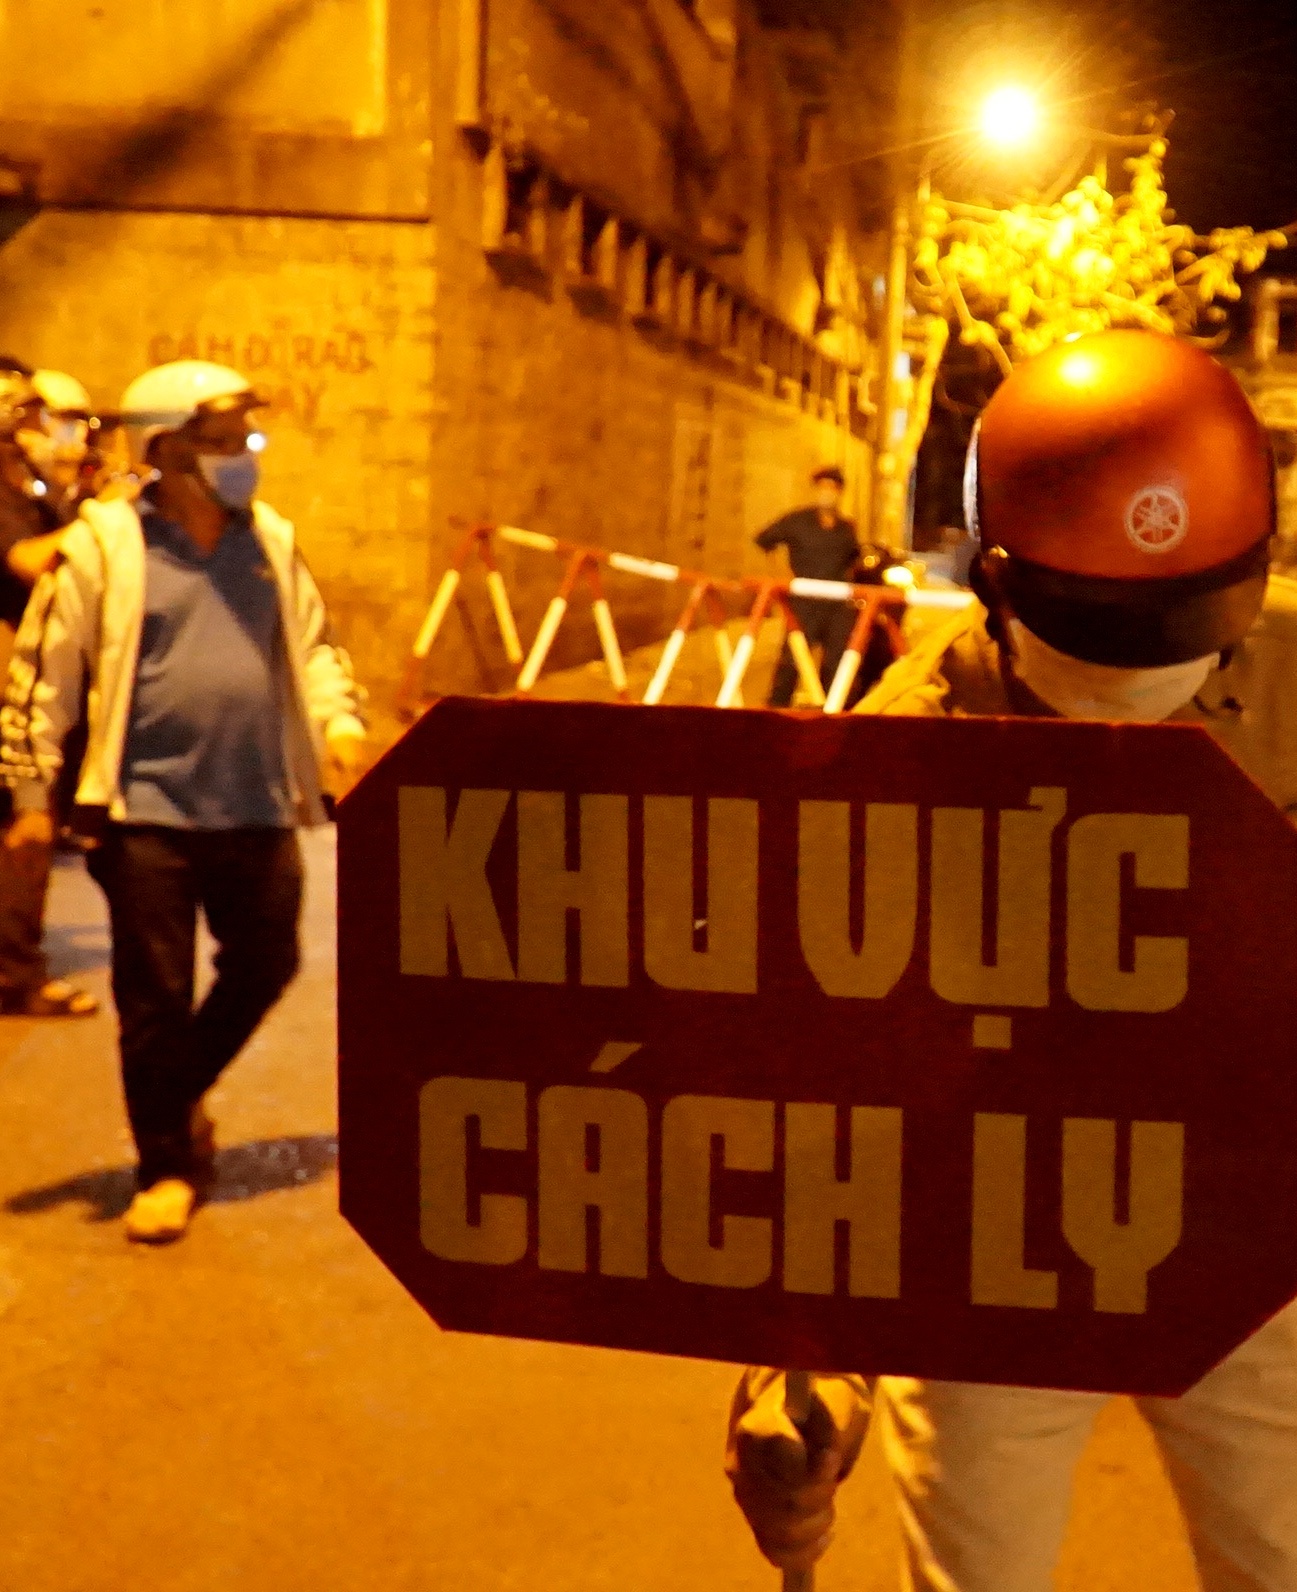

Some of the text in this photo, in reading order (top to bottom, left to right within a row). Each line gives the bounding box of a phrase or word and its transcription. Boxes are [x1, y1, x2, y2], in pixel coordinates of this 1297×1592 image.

[399, 786, 1191, 1050] KHU VỰC
[418, 1041, 1186, 1315] CÁCH LY
